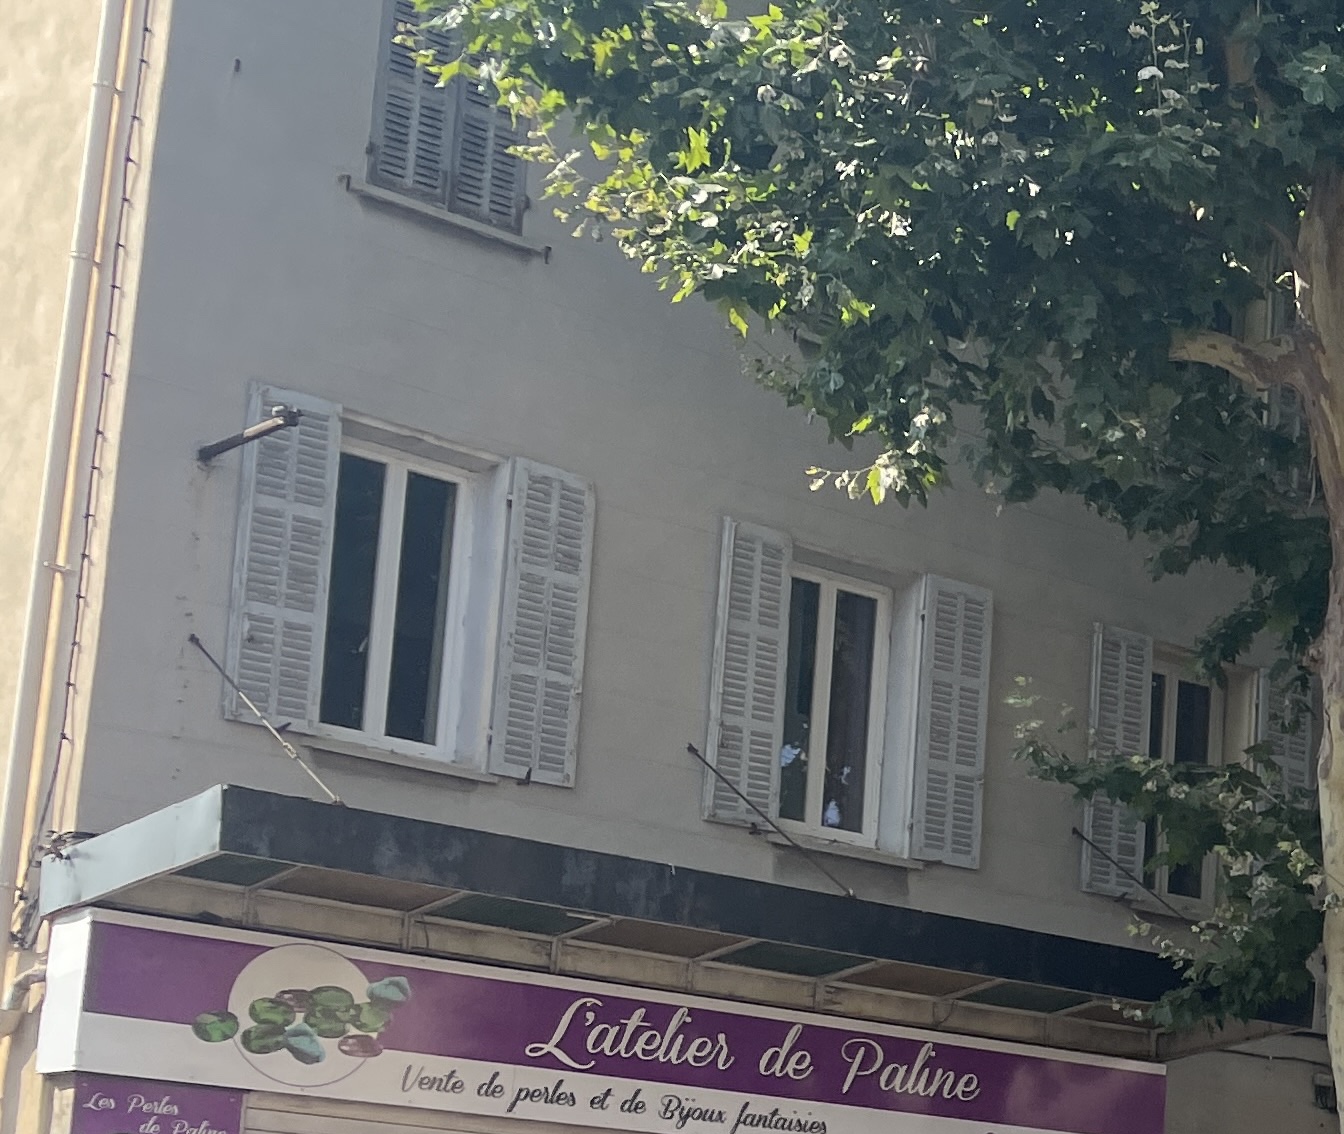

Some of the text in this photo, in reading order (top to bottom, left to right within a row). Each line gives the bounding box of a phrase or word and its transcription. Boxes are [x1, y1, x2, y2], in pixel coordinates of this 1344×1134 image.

[525, 997, 980, 1101] L'atelier de Paline
[82, 1092, 179, 1116] Les Perles
[401, 1064, 464, 1094] Vente
[477, 1071, 504, 1098] de
[506, 1079, 576, 1113] perles
[589, 1087, 615, 1110] et
[620, 1088, 647, 1115] de
[139, 1115, 161, 1134] de
